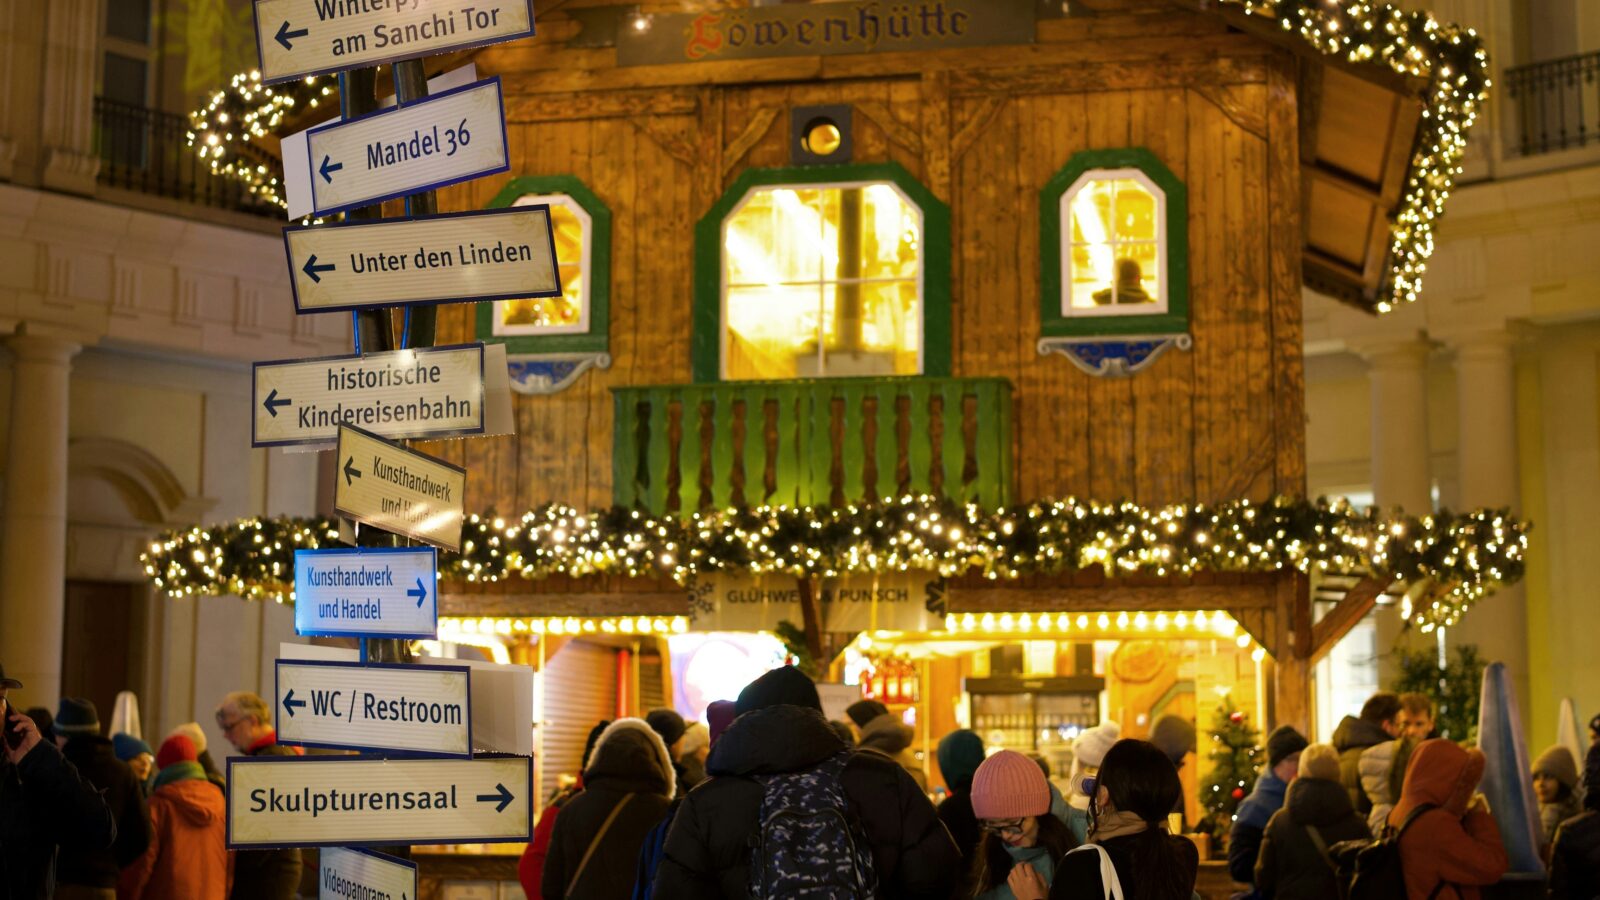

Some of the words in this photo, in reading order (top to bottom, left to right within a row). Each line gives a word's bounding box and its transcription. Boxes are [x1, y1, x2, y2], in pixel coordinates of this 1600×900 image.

[314, 0, 420, 21] Winterpy
[332, 33, 367, 56] am
[374, 11, 455, 48] Sanchi
[461, 7, 500, 31] Tor
[686, 3, 969, 59] Löwenhütte
[366, 125, 440, 171] Mandel
[444, 118, 471, 156] 36
[350, 252, 407, 274] Unter
[414, 247, 452, 269] den
[458, 240, 532, 265] Linden
[327, 363, 441, 391] historische
[299, 395, 471, 428] Kindereisenbahn
[373, 455, 451, 503] Kunsthandwerk
[382, 498, 401, 518] und
[308, 564, 393, 588] Kunsthandwerk
[319, 597, 339, 618] und
[342, 598, 381, 620] Handel
[726, 587, 801, 603] GLÜHWE
[839, 588, 909, 603] PUNSCH
[311, 690, 342, 717] WC
[349, 689, 356, 723] /
[364, 692, 461, 725] Restroom
[250, 784, 457, 817] Skulpturensaal
[323, 866, 391, 900] Videopanorama
